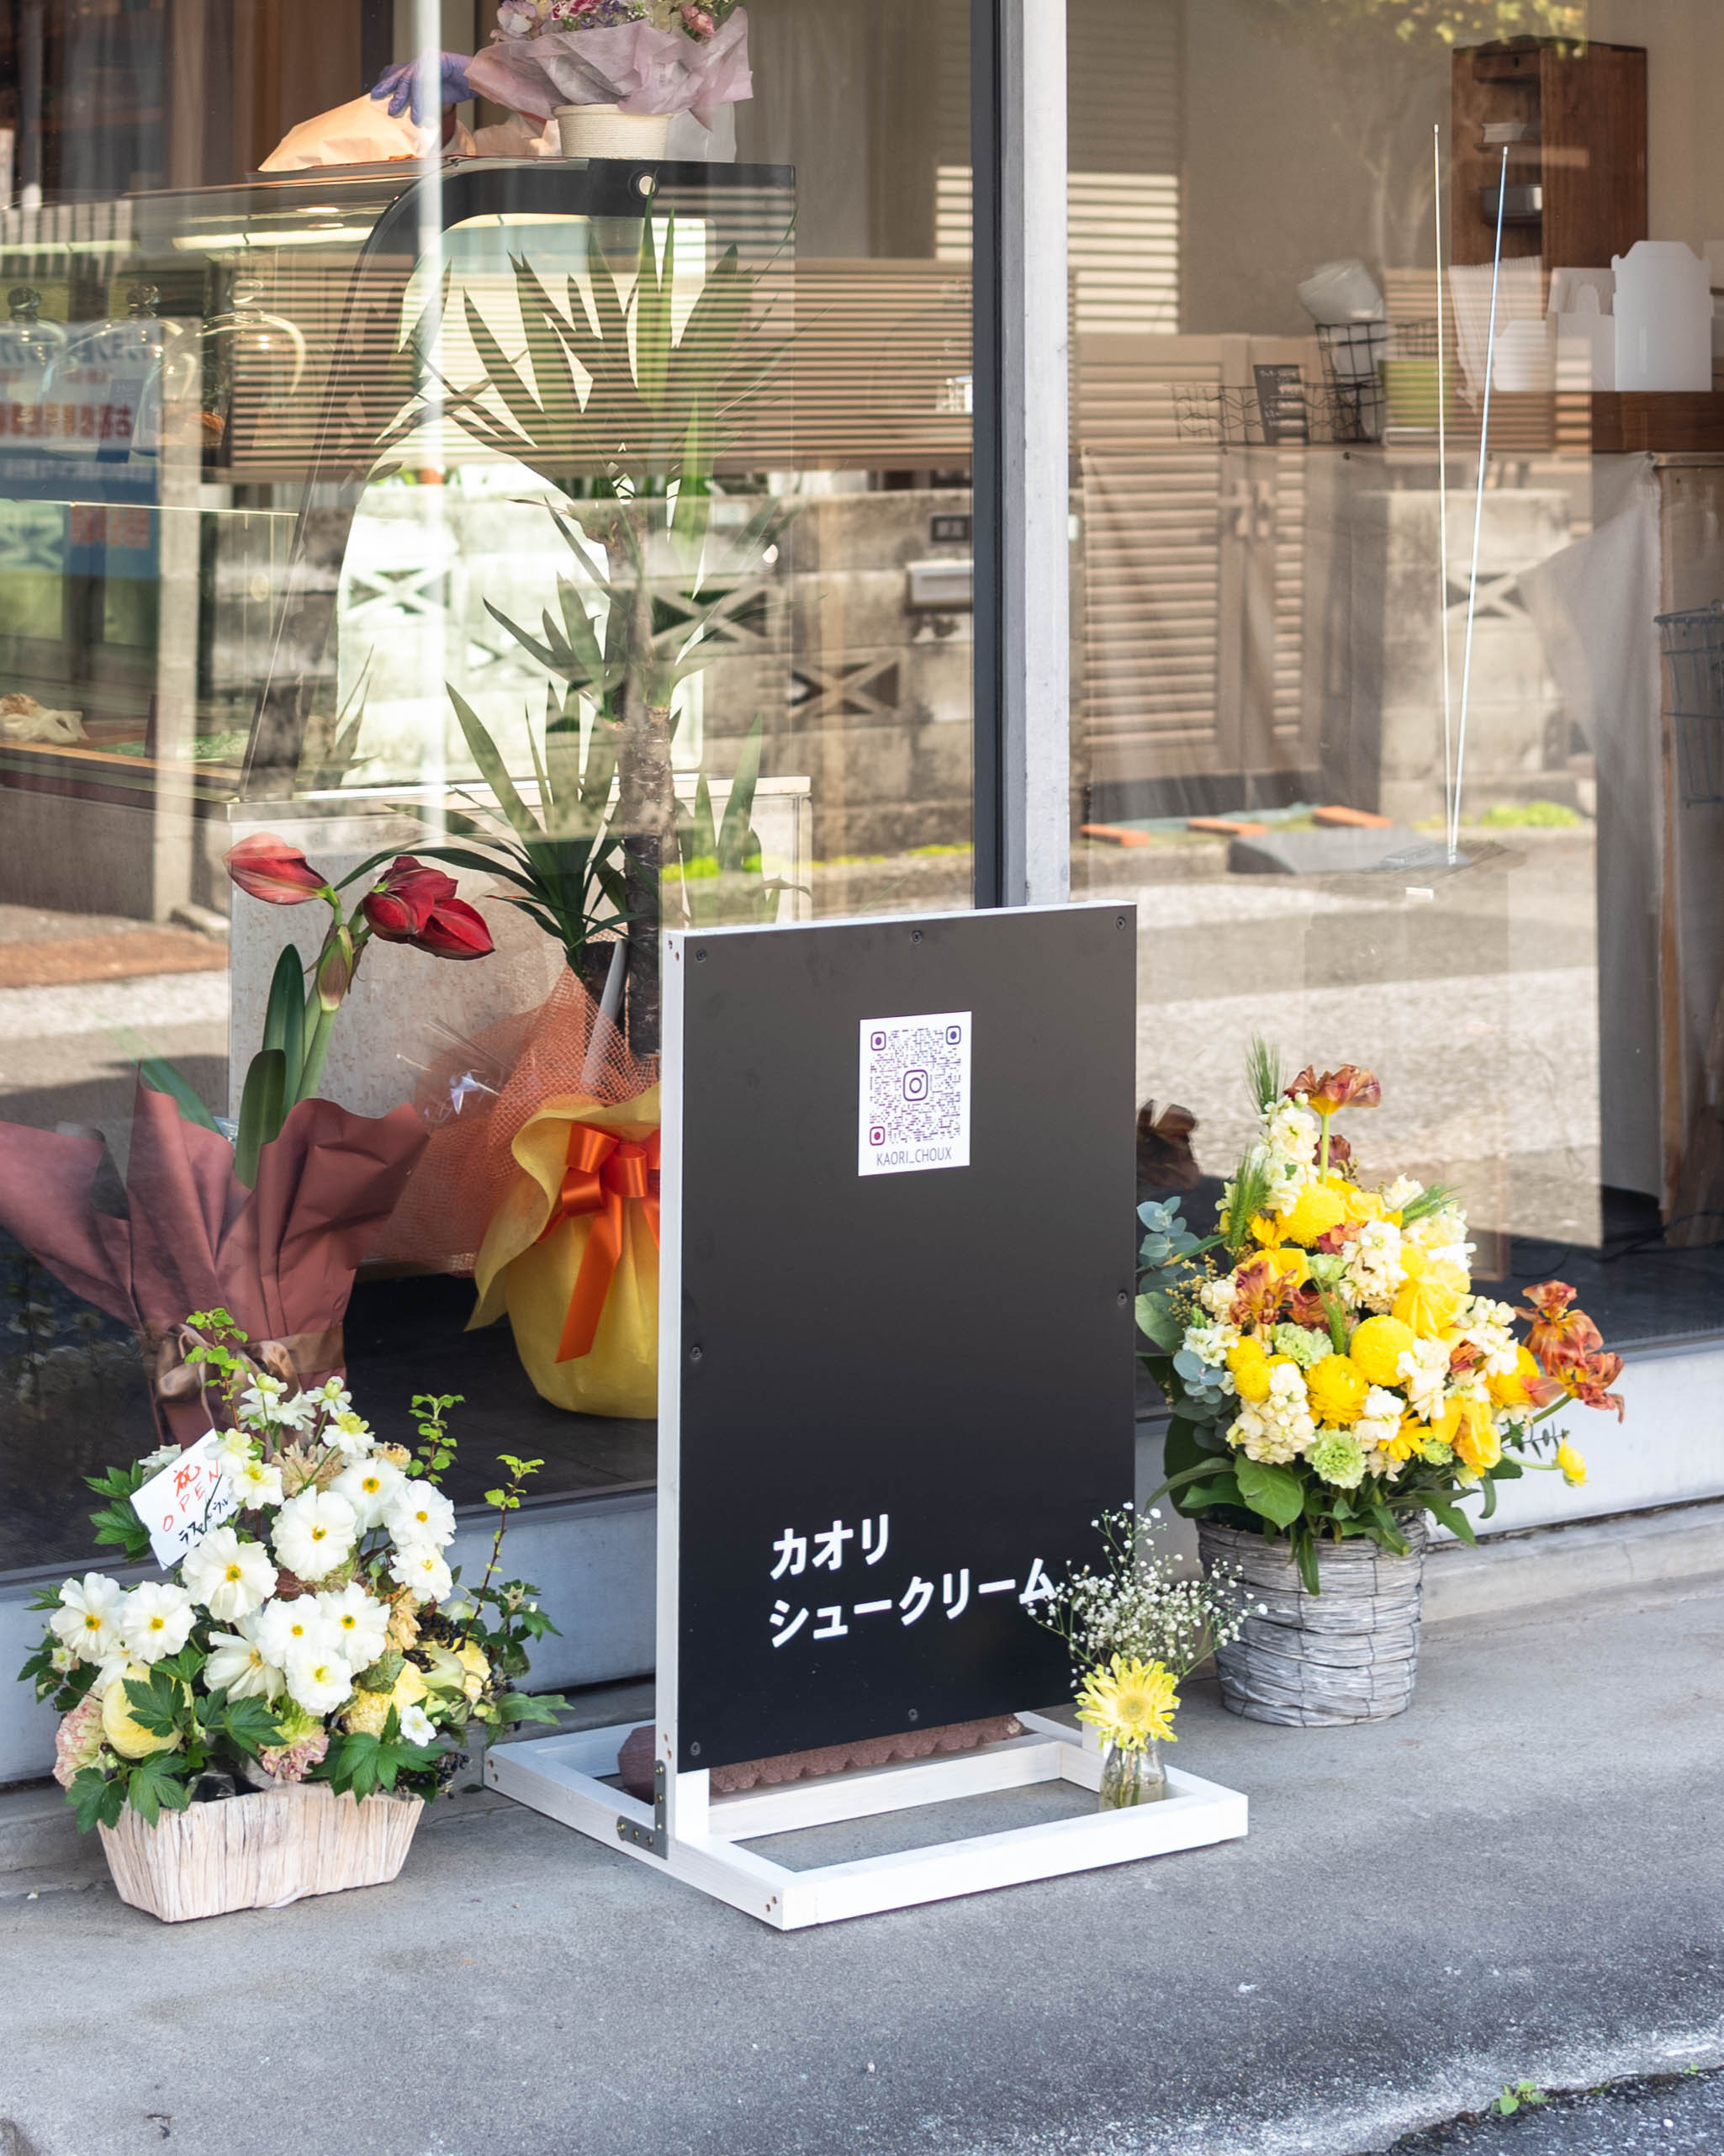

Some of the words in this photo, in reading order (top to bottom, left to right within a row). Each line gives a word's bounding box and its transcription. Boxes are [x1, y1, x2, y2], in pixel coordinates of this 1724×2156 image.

[876, 1147, 952, 1166] KAORI_CHOUX
[162, 1459, 220, 1532] OPEN
[769, 1513, 889, 1580] カオリ
[769, 1557, 1059, 1648] シュークリーム
